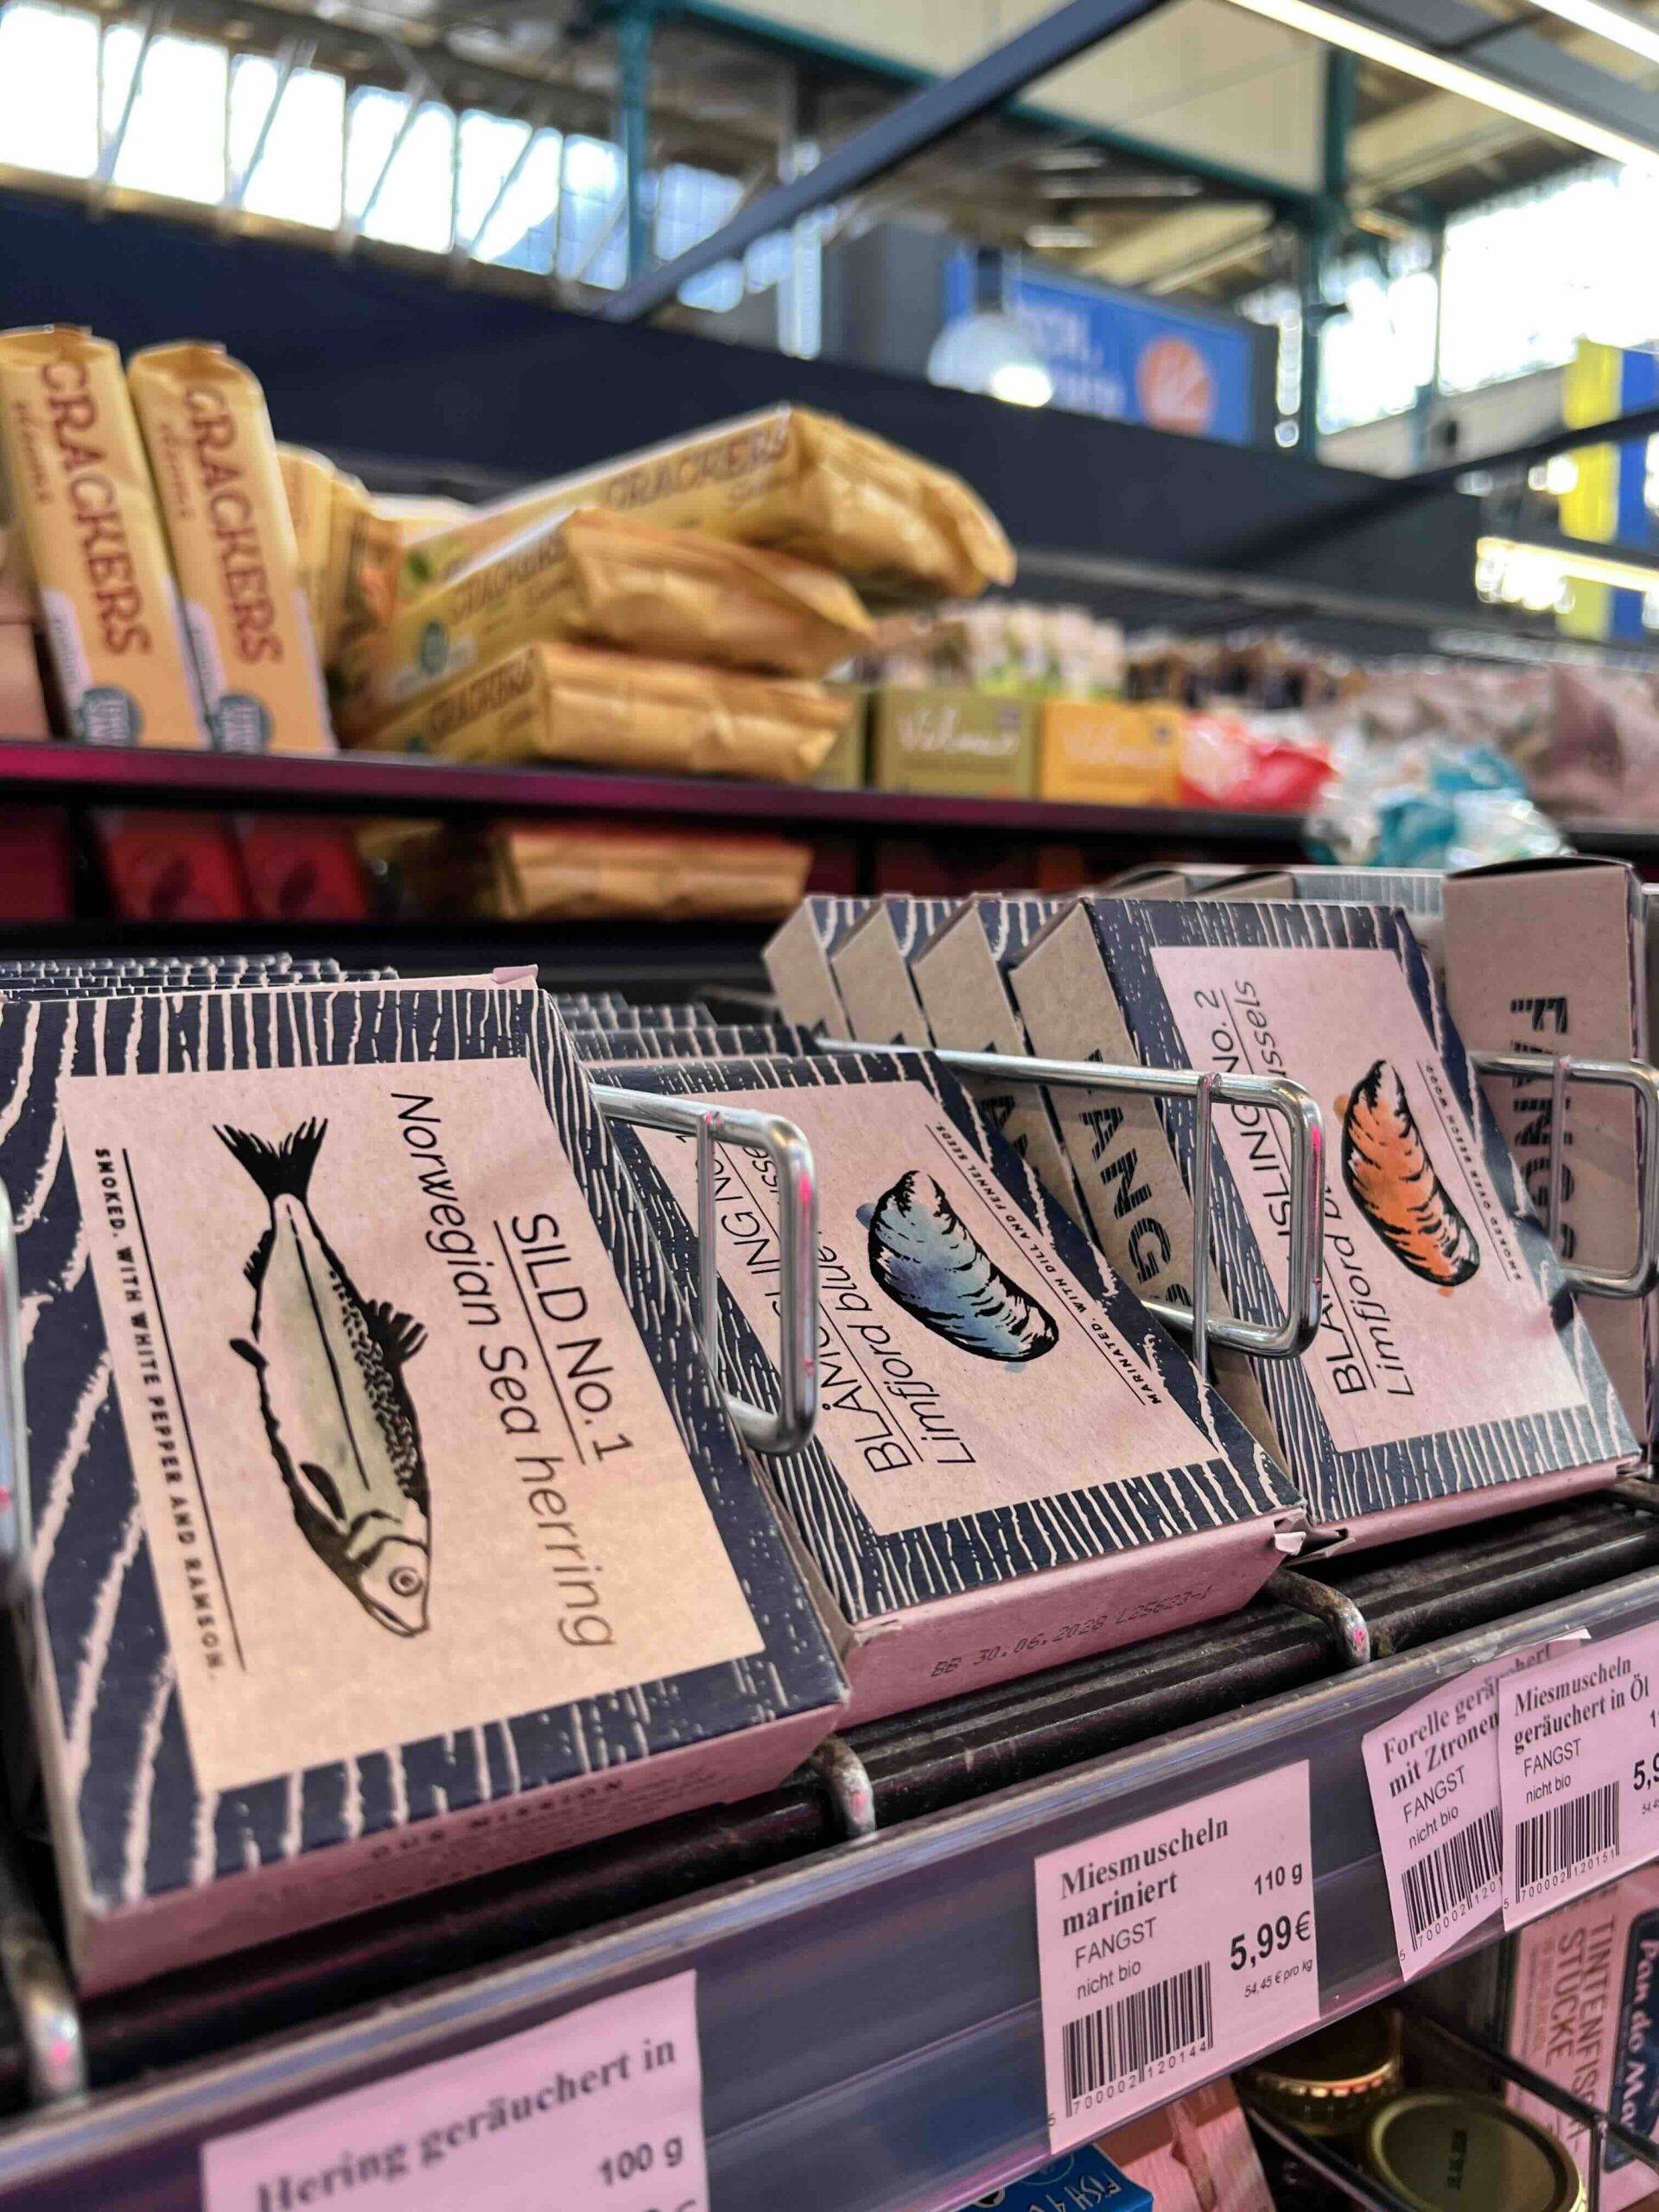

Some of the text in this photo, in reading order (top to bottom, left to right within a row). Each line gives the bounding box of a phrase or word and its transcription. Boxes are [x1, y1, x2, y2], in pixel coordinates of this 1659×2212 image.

[41, 362, 154, 657] CRACKERS
[182, 386, 285, 665] CRACKERS
[1194, 989, 1220, 1009] 2
[968, 1164, 1007, 1211] FENNEL
[1235, 980, 1414, 1396] Limfjord ssels
[1005, 1215, 1031, 1240] AND
[1030, 1243, 1057, 1273] DILL
[1231, 1104, 1367, 1395] BLSLING
[1054, 1278, 1087, 1313] WITH
[95, 1148, 126, 1237] SMOKED.
[117, 1246, 143, 1302] WITH
[130, 1312, 162, 1385] WHITE
[149, 1395, 182, 1484] PEPPER
[170, 1495, 196, 1545] AND
[512, 1211, 633, 1462] SILD No. 1
[818, 1245, 976, 1464] Limfjord blue
[1091, 1318, 1162, 1404] MARINATED.
[391, 1092, 617, 1647] Norwegian Sea herring
[1514, 1656, 1632, 1717] Miesmuscheln
[1514, 1672, 1649, 1756] geräuchert in Öl
[1383, 1710, 1449, 1764] Forelle
[1523, 1738, 1583, 1778] FANGST
[1389, 1761, 1421, 1797] mit
[1402, 1765, 1465, 1823] FANGST
[1525, 1783, 1554, 1804] nicht
[1554, 1773, 1572, 1794] bio
[1408, 1805, 1459, 1849] nicht bio
[1058, 1817, 1230, 1899] Miesmuscheln
[1521, 1872, 1567, 1901] 700002
[1062, 1862, 1304, 1937] mariniert 110 g
[1074, 1910, 1311, 1971] FANGST 5,99€
[1077, 1970, 1115, 2000] nicht
[1119, 1960, 1141, 1984] bio
[1283, 1966, 1300, 1984] pro
[1302, 1959, 1313, 1973] kg
[1628, 2010, 1654, 2055] do
[1072, 2075, 1136, 2115] 700002
[1147, 2040, 1206, 2078] 120144
[257, 2037, 676, 2212] Hering geräuchert in
[598, 2137, 683, 2185] 100 g
